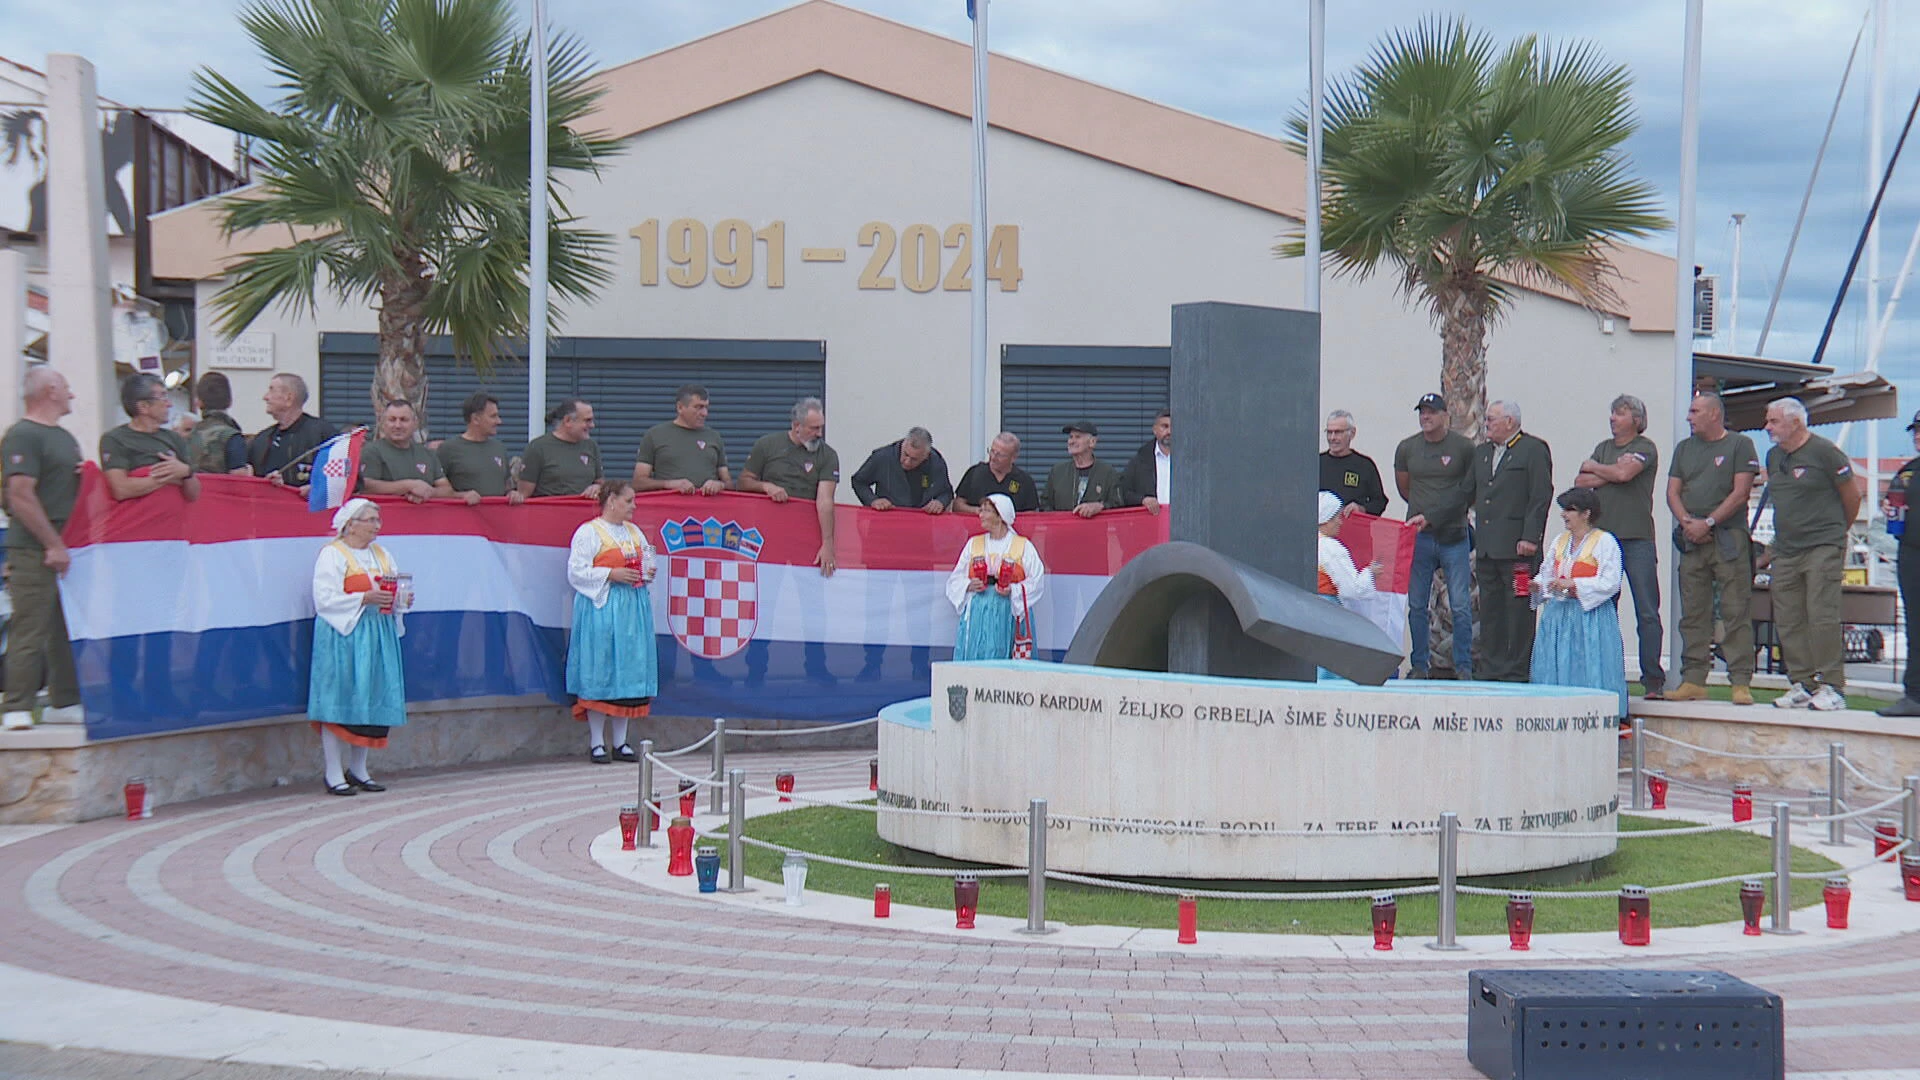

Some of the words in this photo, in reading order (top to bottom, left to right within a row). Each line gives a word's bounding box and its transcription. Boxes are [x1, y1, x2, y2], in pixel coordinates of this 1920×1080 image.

[629, 217, 785, 289] 1991
[857, 221, 1024, 293] 2024
[974, 687, 1035, 707] MARINKO
[1040, 693, 1103, 713] KARDUM
[1118, 696, 1184, 720] ŽELJKO
[1194, 704, 1275, 727] GRBELJA
[1285, 705, 1327, 727] ŠIME
[1333, 708, 1421, 731] ŠUNJERGA
[1432, 712, 1469, 731] MIŠE
[1474, 716, 1504, 732] IVAS
[1516, 716, 1569, 732] BORISLAV
[1475, 816, 1492, 831] ZA
[1498, 816, 1513, 832] TE
[1521, 809, 1578, 830] ŽRTVUJEMO
